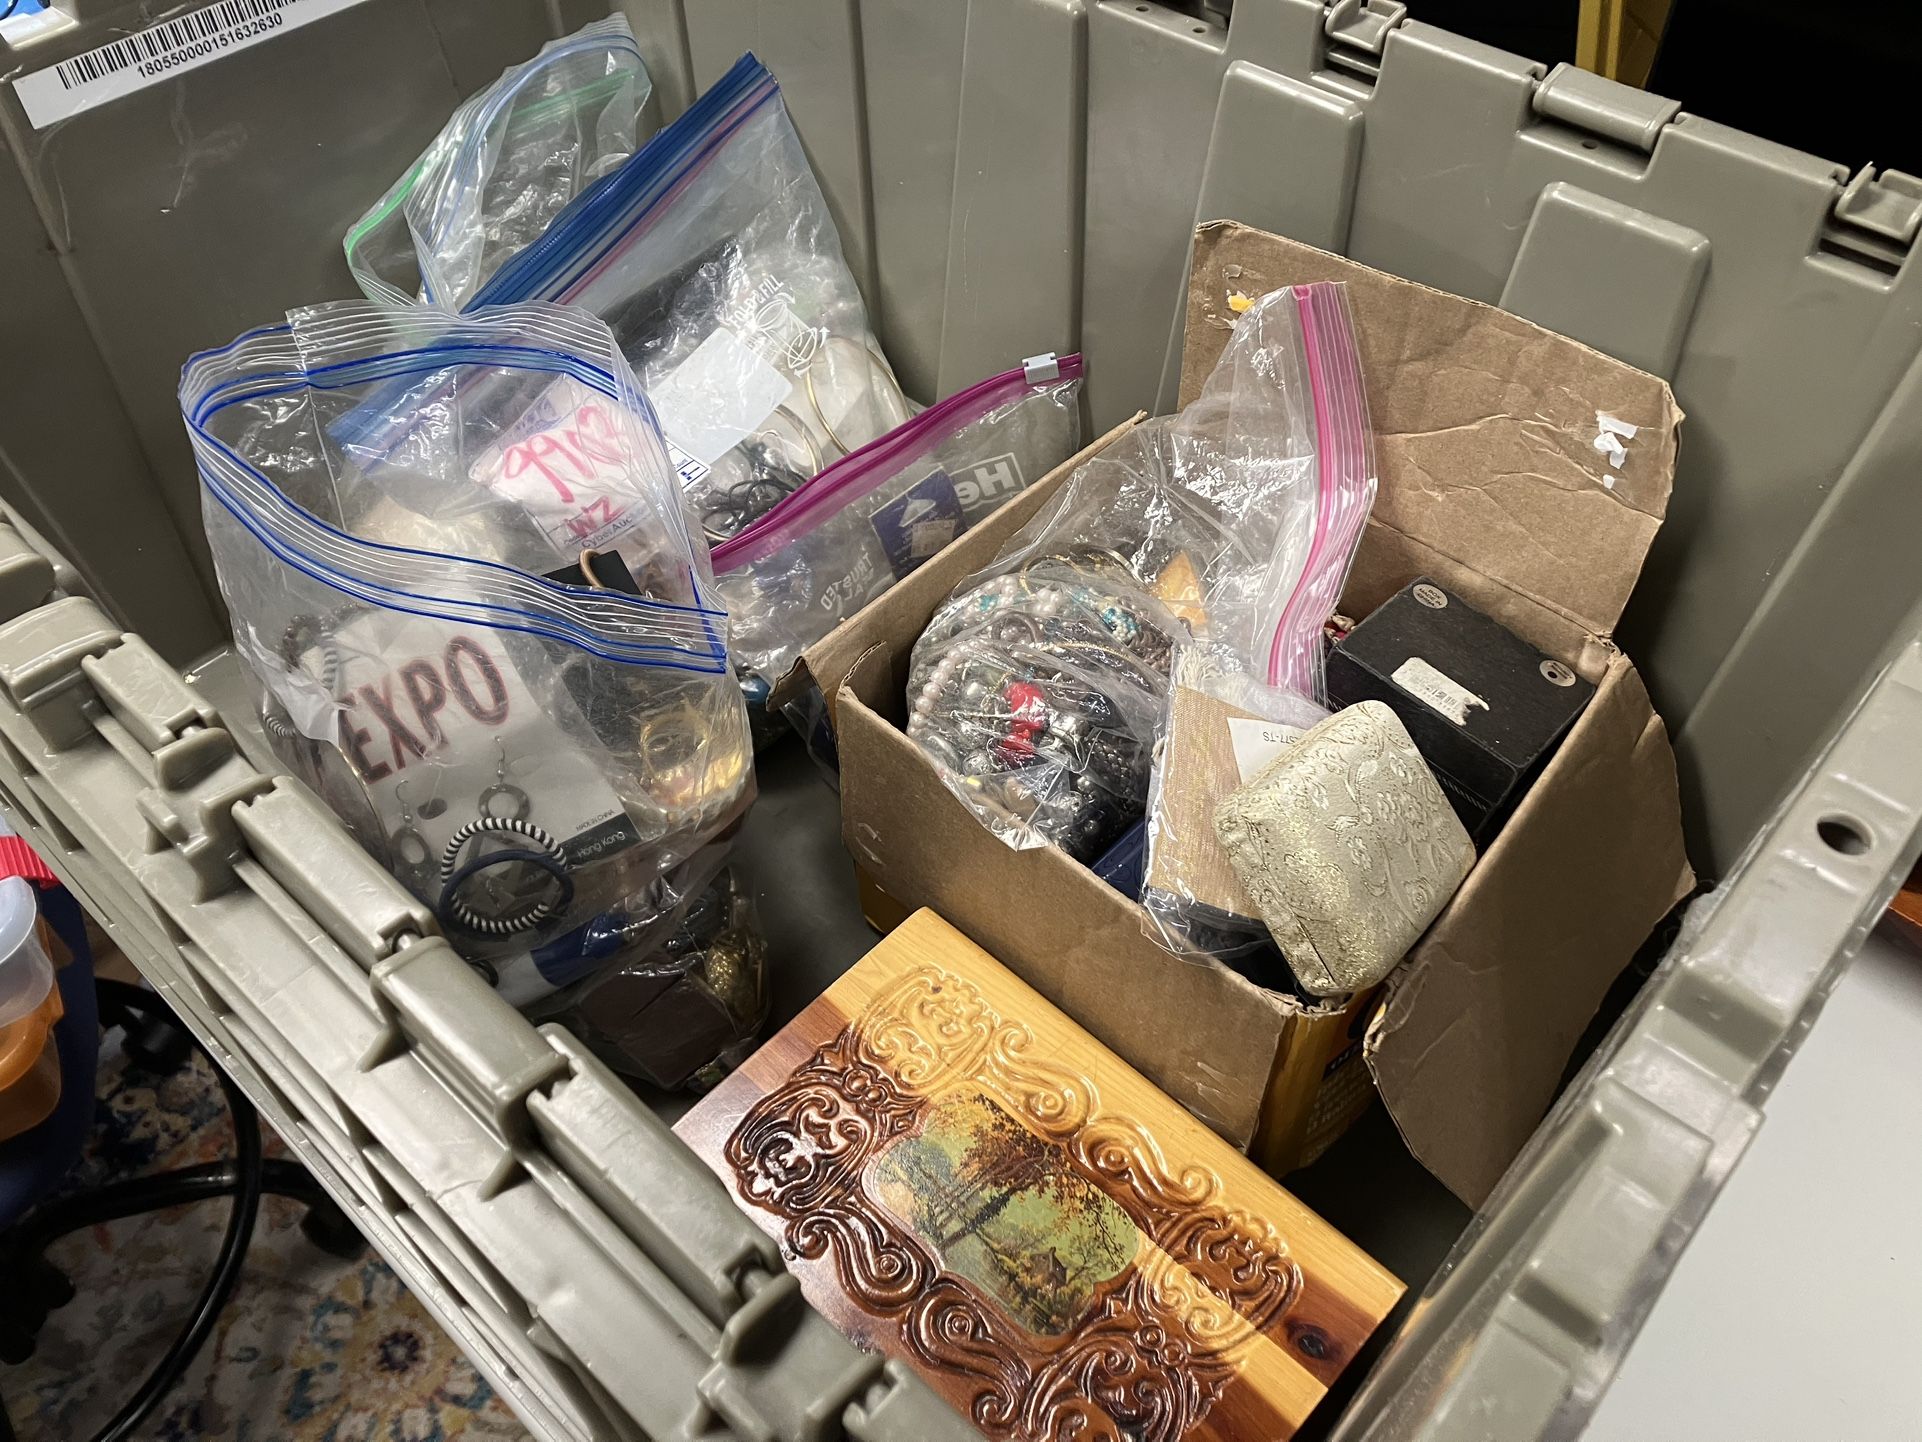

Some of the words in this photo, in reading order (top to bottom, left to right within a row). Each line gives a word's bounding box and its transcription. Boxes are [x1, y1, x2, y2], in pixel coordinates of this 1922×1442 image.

[137, 12, 283, 78] 180550000151632630
[758, 274, 784, 299] FILL
[335, 636, 509, 785] EXPO
[576, 842, 602, 858] Hong
[602, 831, 626, 847] Kong
